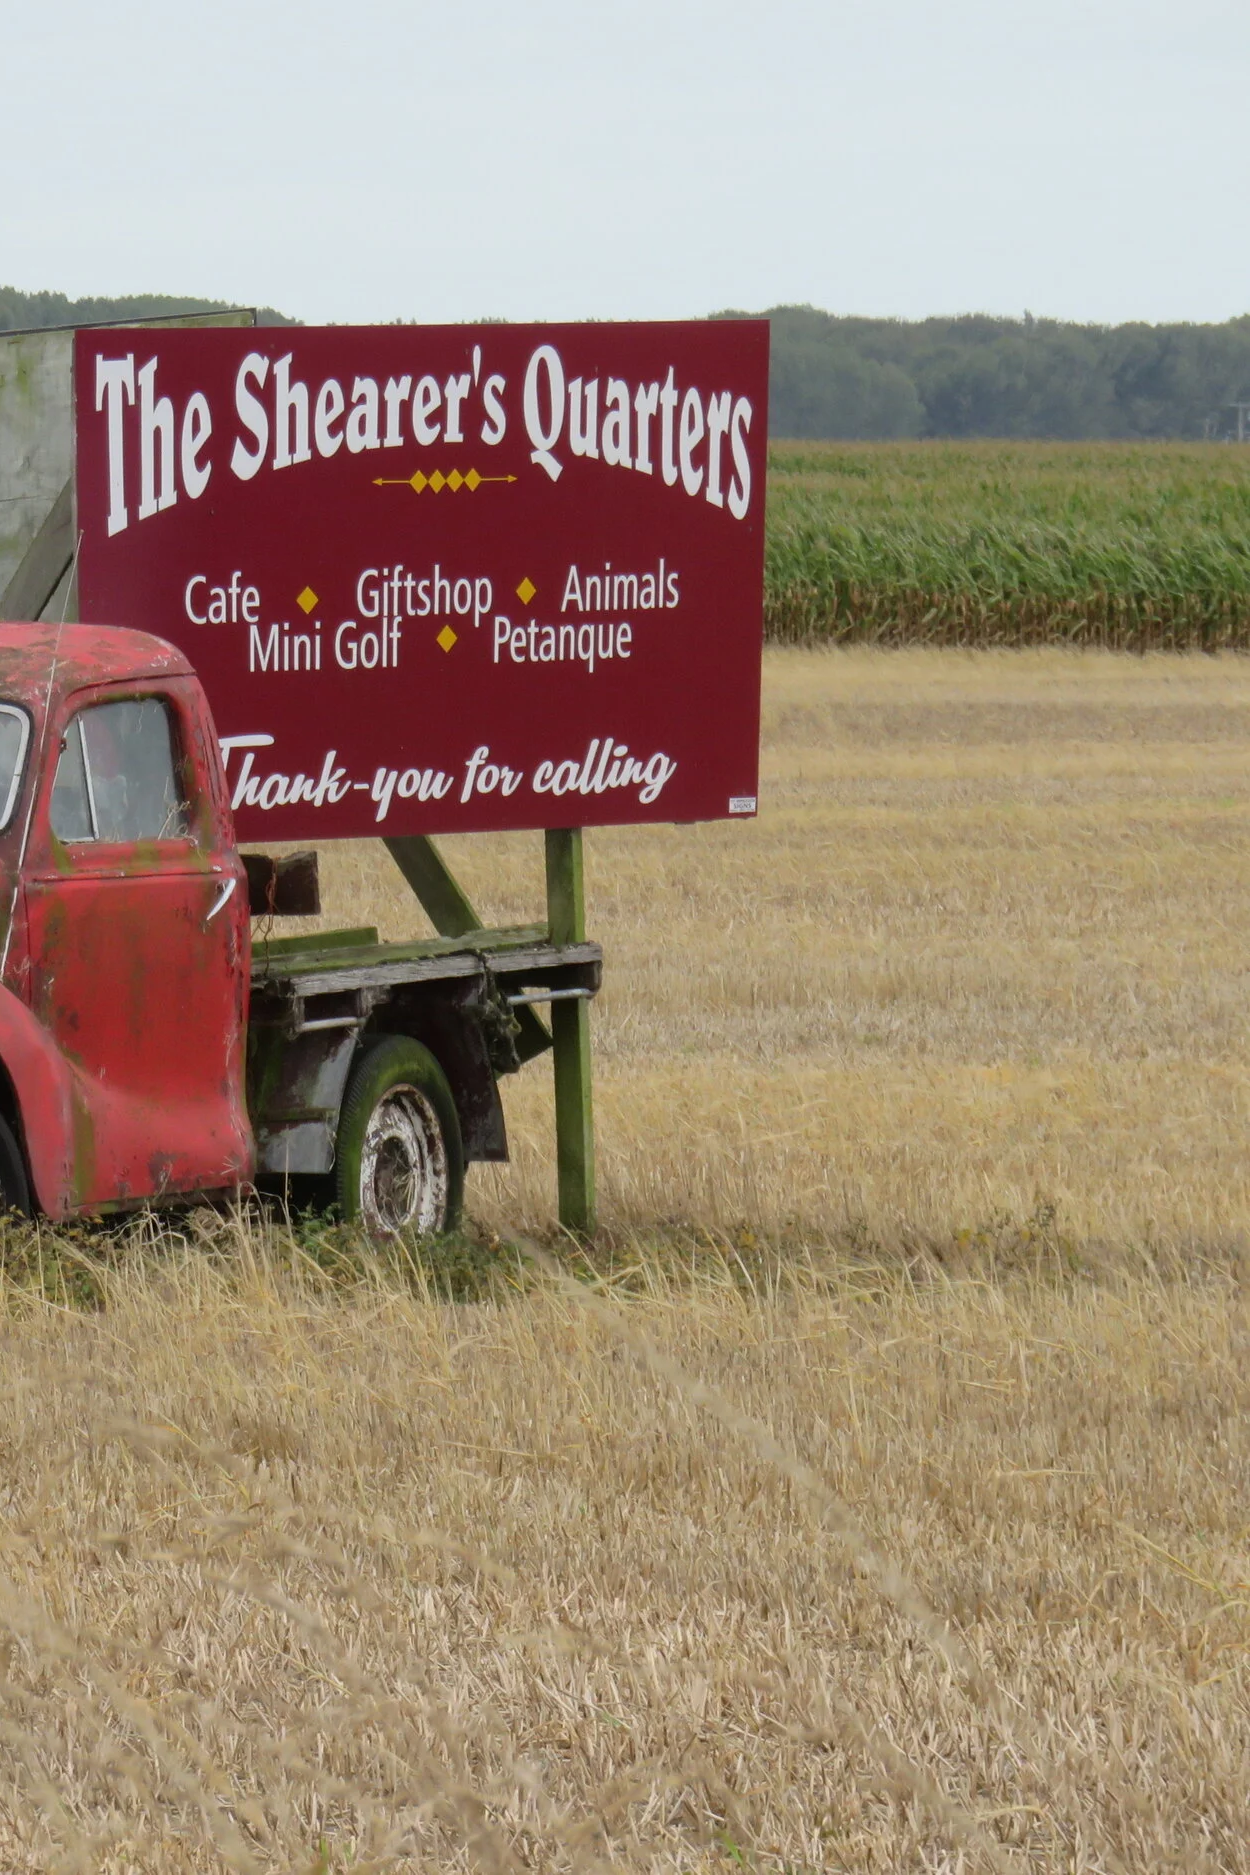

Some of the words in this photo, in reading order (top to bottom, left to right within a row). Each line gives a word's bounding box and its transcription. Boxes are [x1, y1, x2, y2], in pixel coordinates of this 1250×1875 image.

[96, 354, 211, 537] The
[231, 345, 507, 480] Shearer's
[524, 345, 752, 520] Quarters
[185, 571, 260, 625] Cafe
[357, 565, 493, 627] Giftshop
[561, 558, 680, 612] Animals
[250, 622, 322, 673] Mini
[335, 616, 402, 669] Golf
[494, 616, 633, 673] Petanque
[218, 735, 454, 822] Thank-you
[461, 746, 524, 804] for
[532, 737, 678, 804] calling
